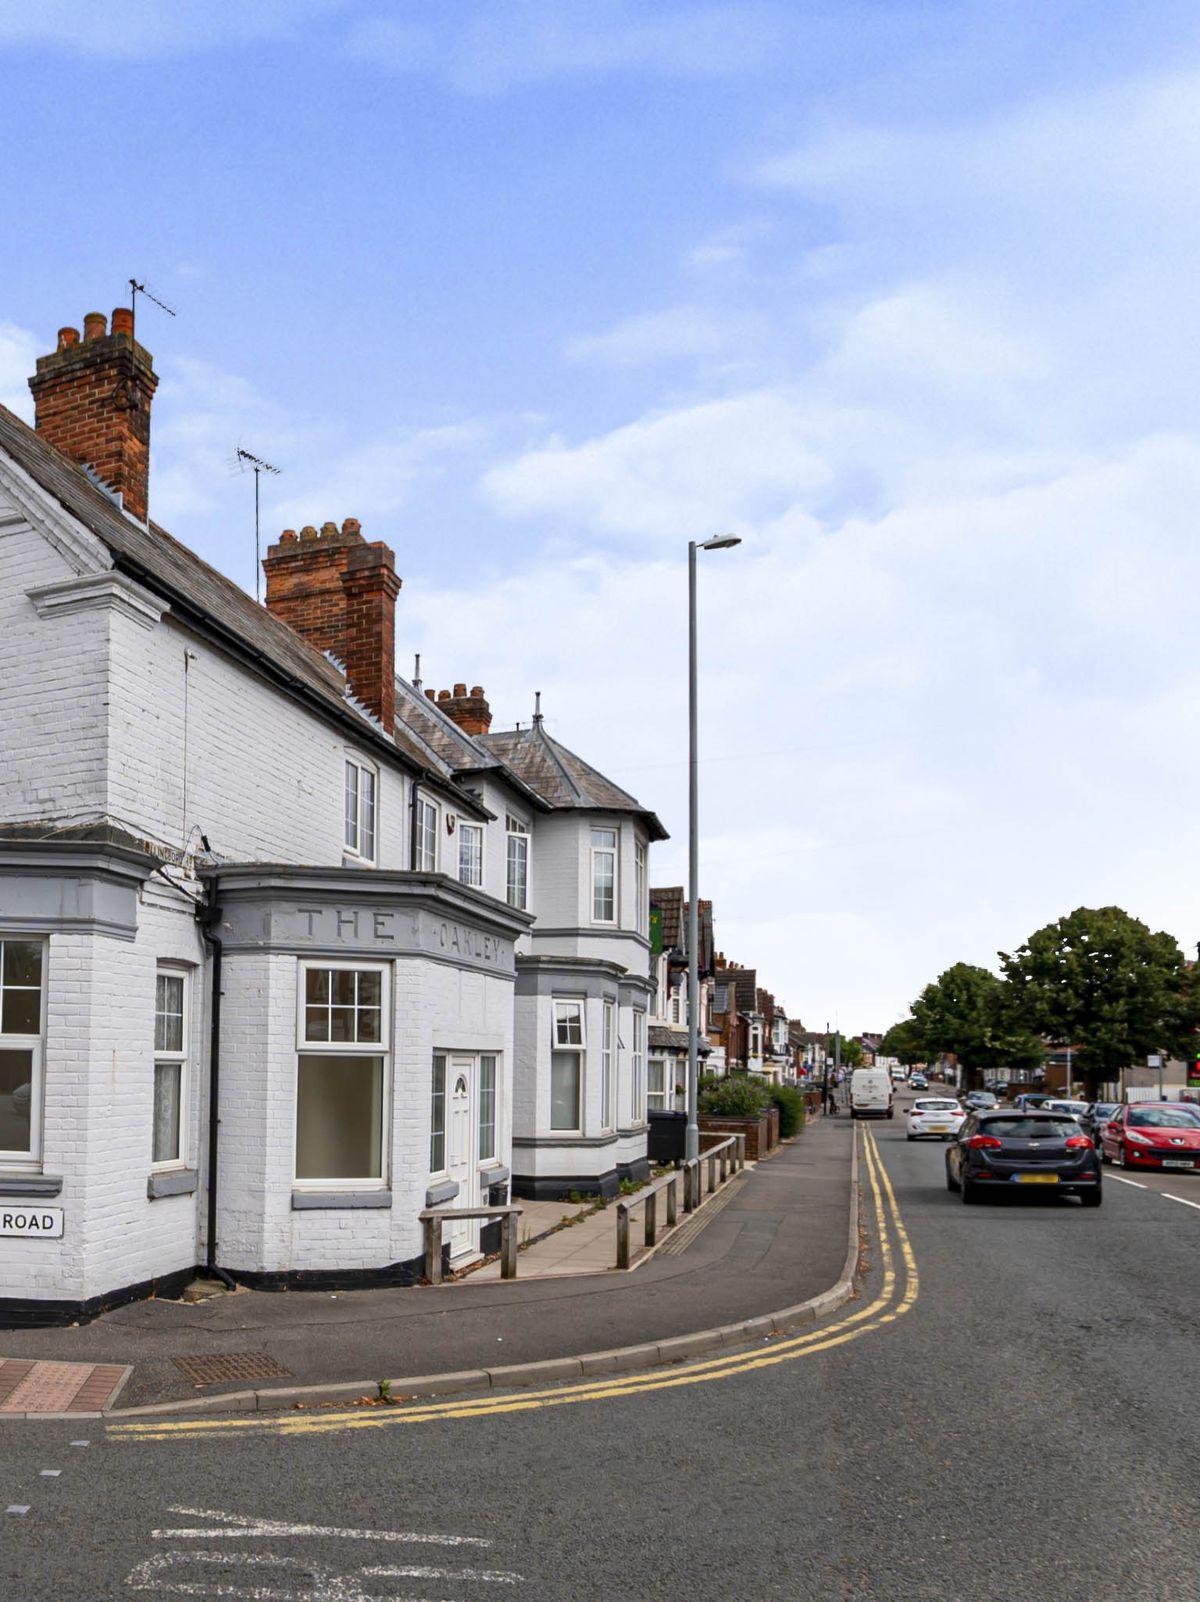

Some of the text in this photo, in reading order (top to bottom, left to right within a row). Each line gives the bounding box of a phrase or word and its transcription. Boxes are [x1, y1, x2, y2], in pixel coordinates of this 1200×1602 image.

[297, 908, 500, 963] THE OAKLEY
[2, 1213, 54, 1230] ROAD
